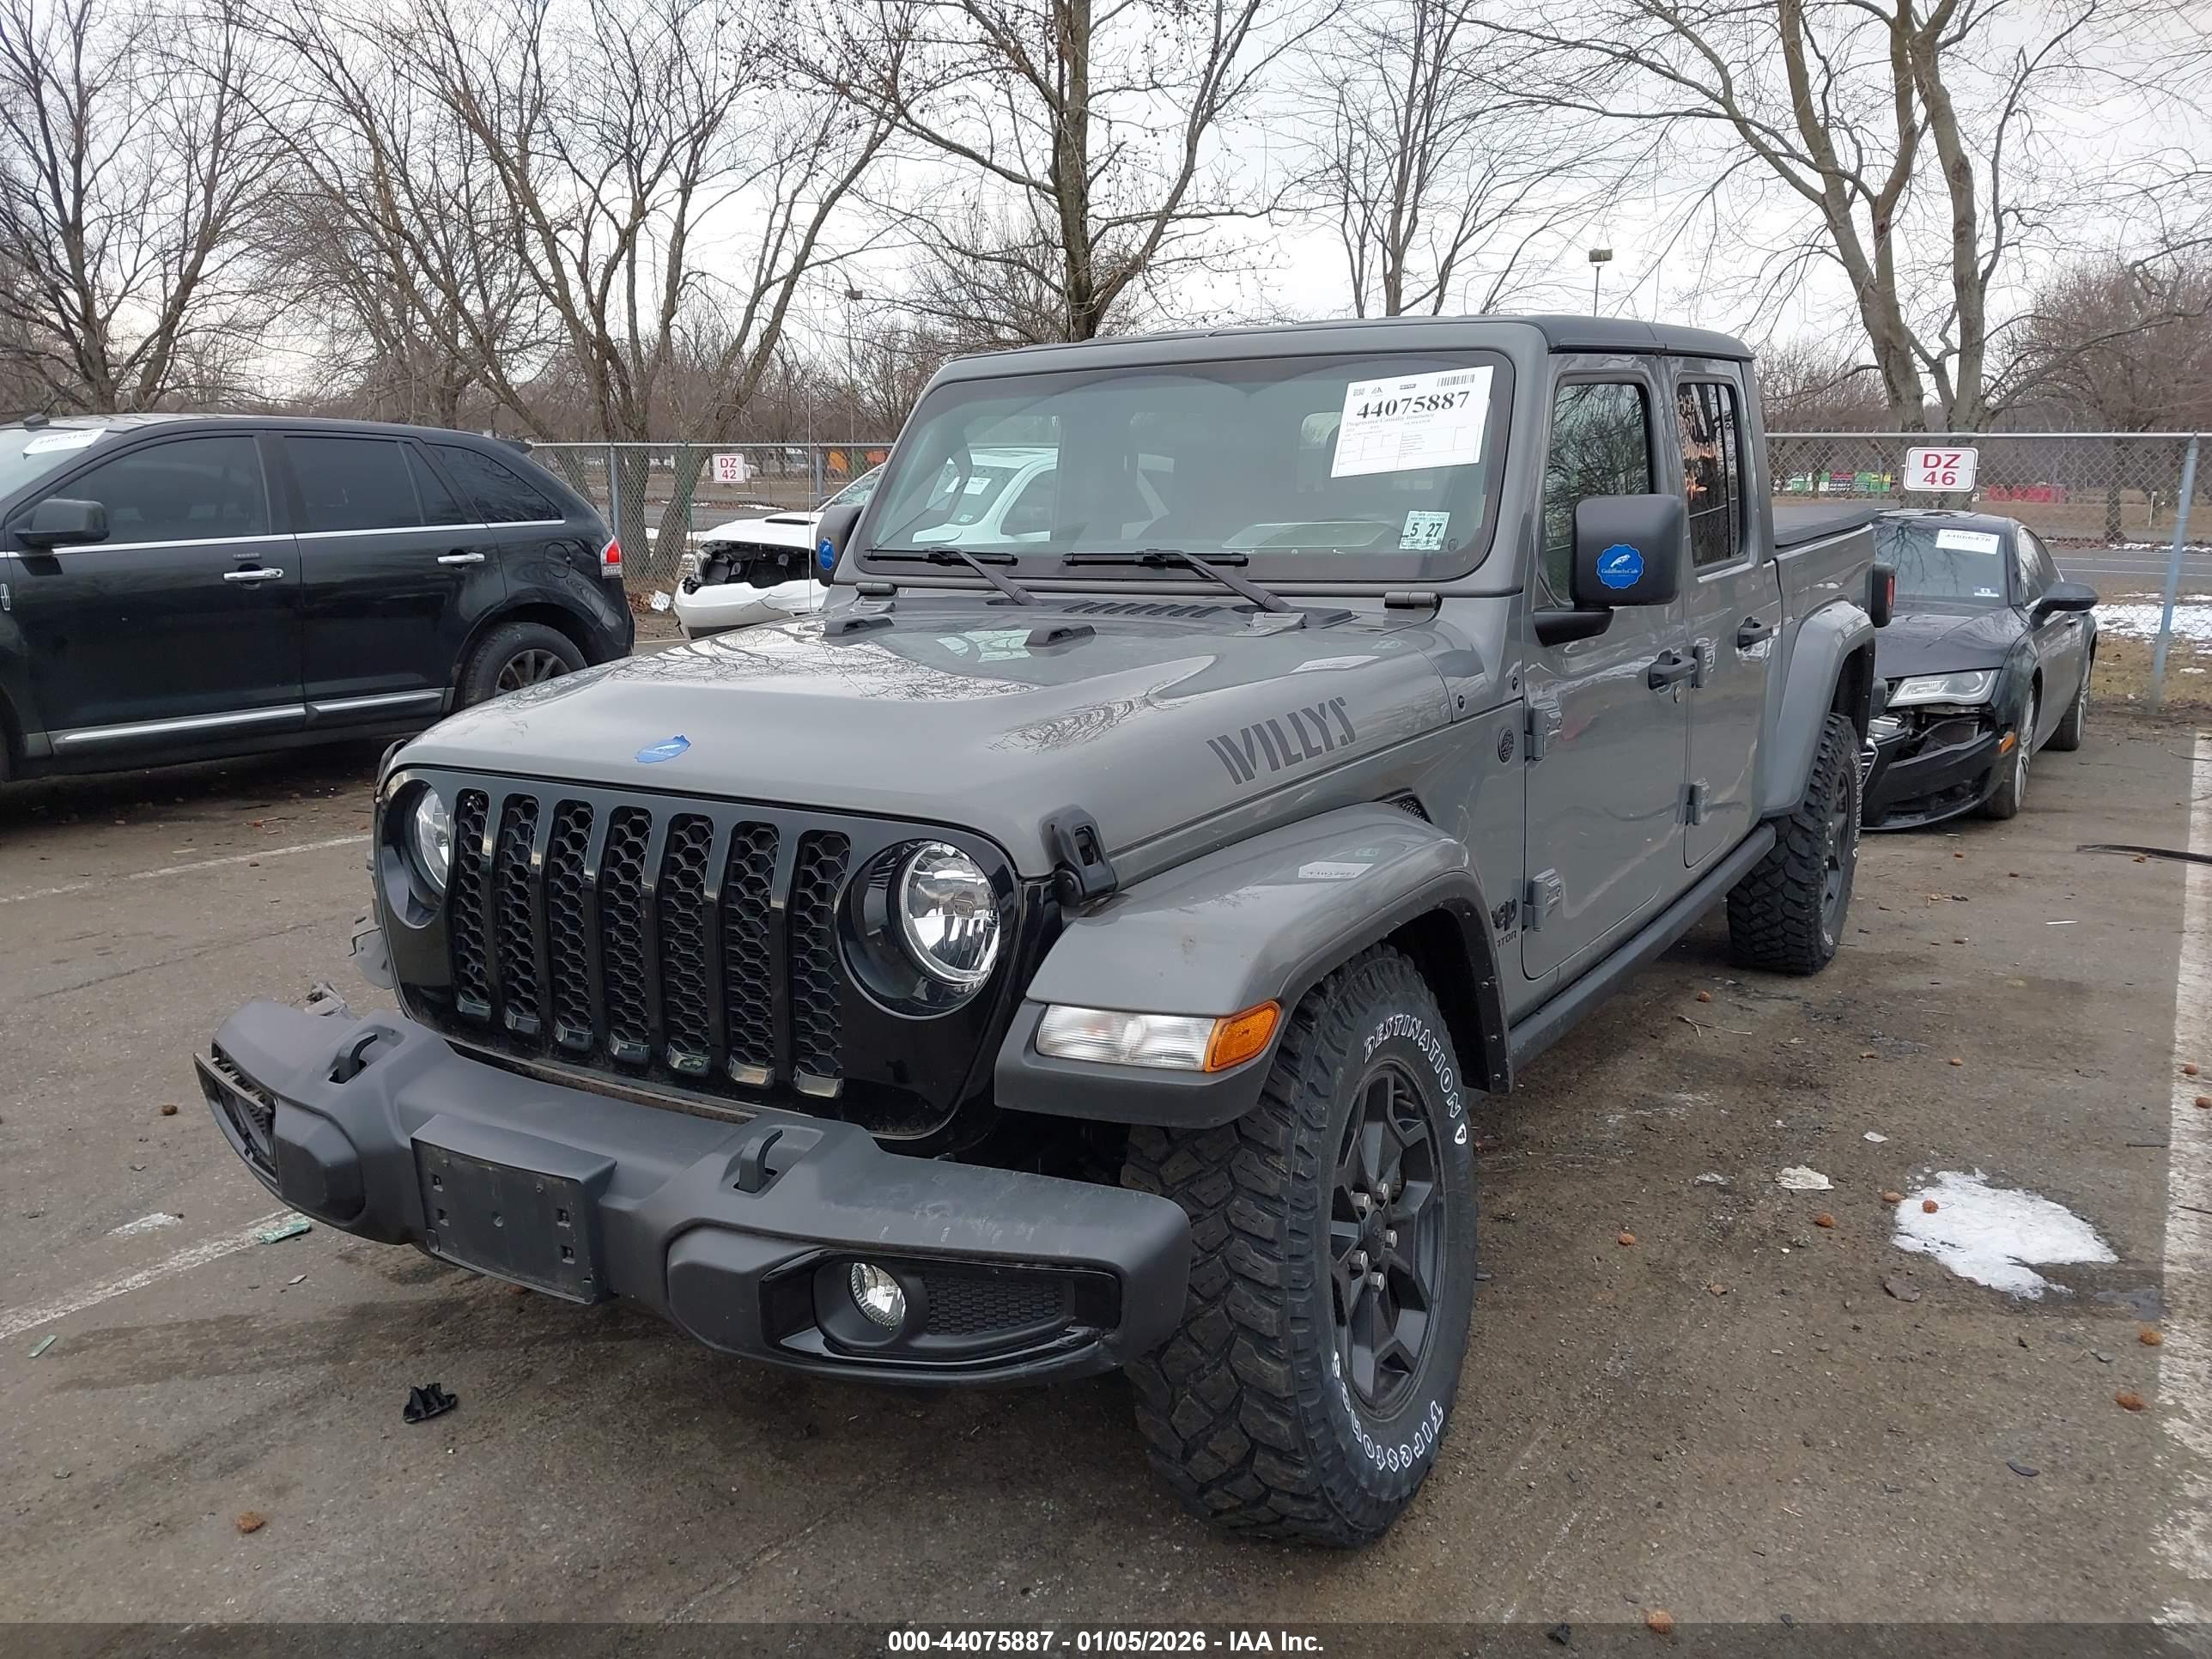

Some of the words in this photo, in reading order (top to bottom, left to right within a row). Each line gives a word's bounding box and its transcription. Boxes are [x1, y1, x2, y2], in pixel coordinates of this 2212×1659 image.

[1357, 391, 1470, 419] 44075887
[720, 458, 737, 468] DZ
[1923, 453, 1961, 469] DZ
[721, 469, 737, 480] 42
[1923, 471, 1957, 486] 46
[1410, 522, 1419, 538] 5
[1425, 522, 1443, 538] 27
[1206, 696, 1356, 785] WILLYS
[1363, 1012, 1462, 1119] DESTINATION
